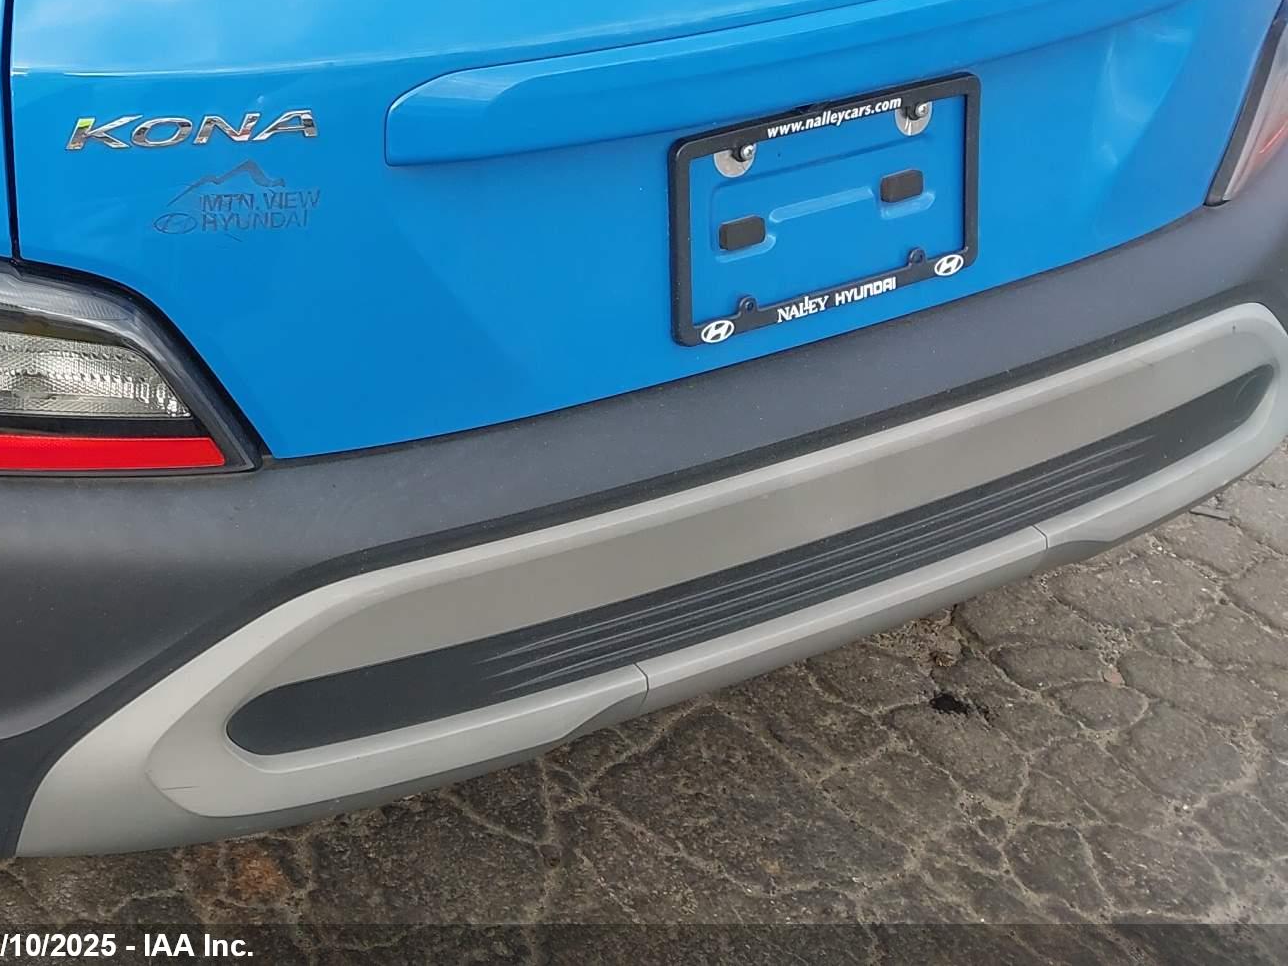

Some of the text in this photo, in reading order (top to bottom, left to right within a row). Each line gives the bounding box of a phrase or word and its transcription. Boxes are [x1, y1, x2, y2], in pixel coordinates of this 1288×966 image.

[66, 109, 318, 150] KONA
[767, 97, 902, 138] www.nalleycars.com
[200, 210, 309, 232] HYUNDAI
[263, 190, 320, 211] VIEW
[777, 276, 896, 323] NALLEY HYUNDAI
